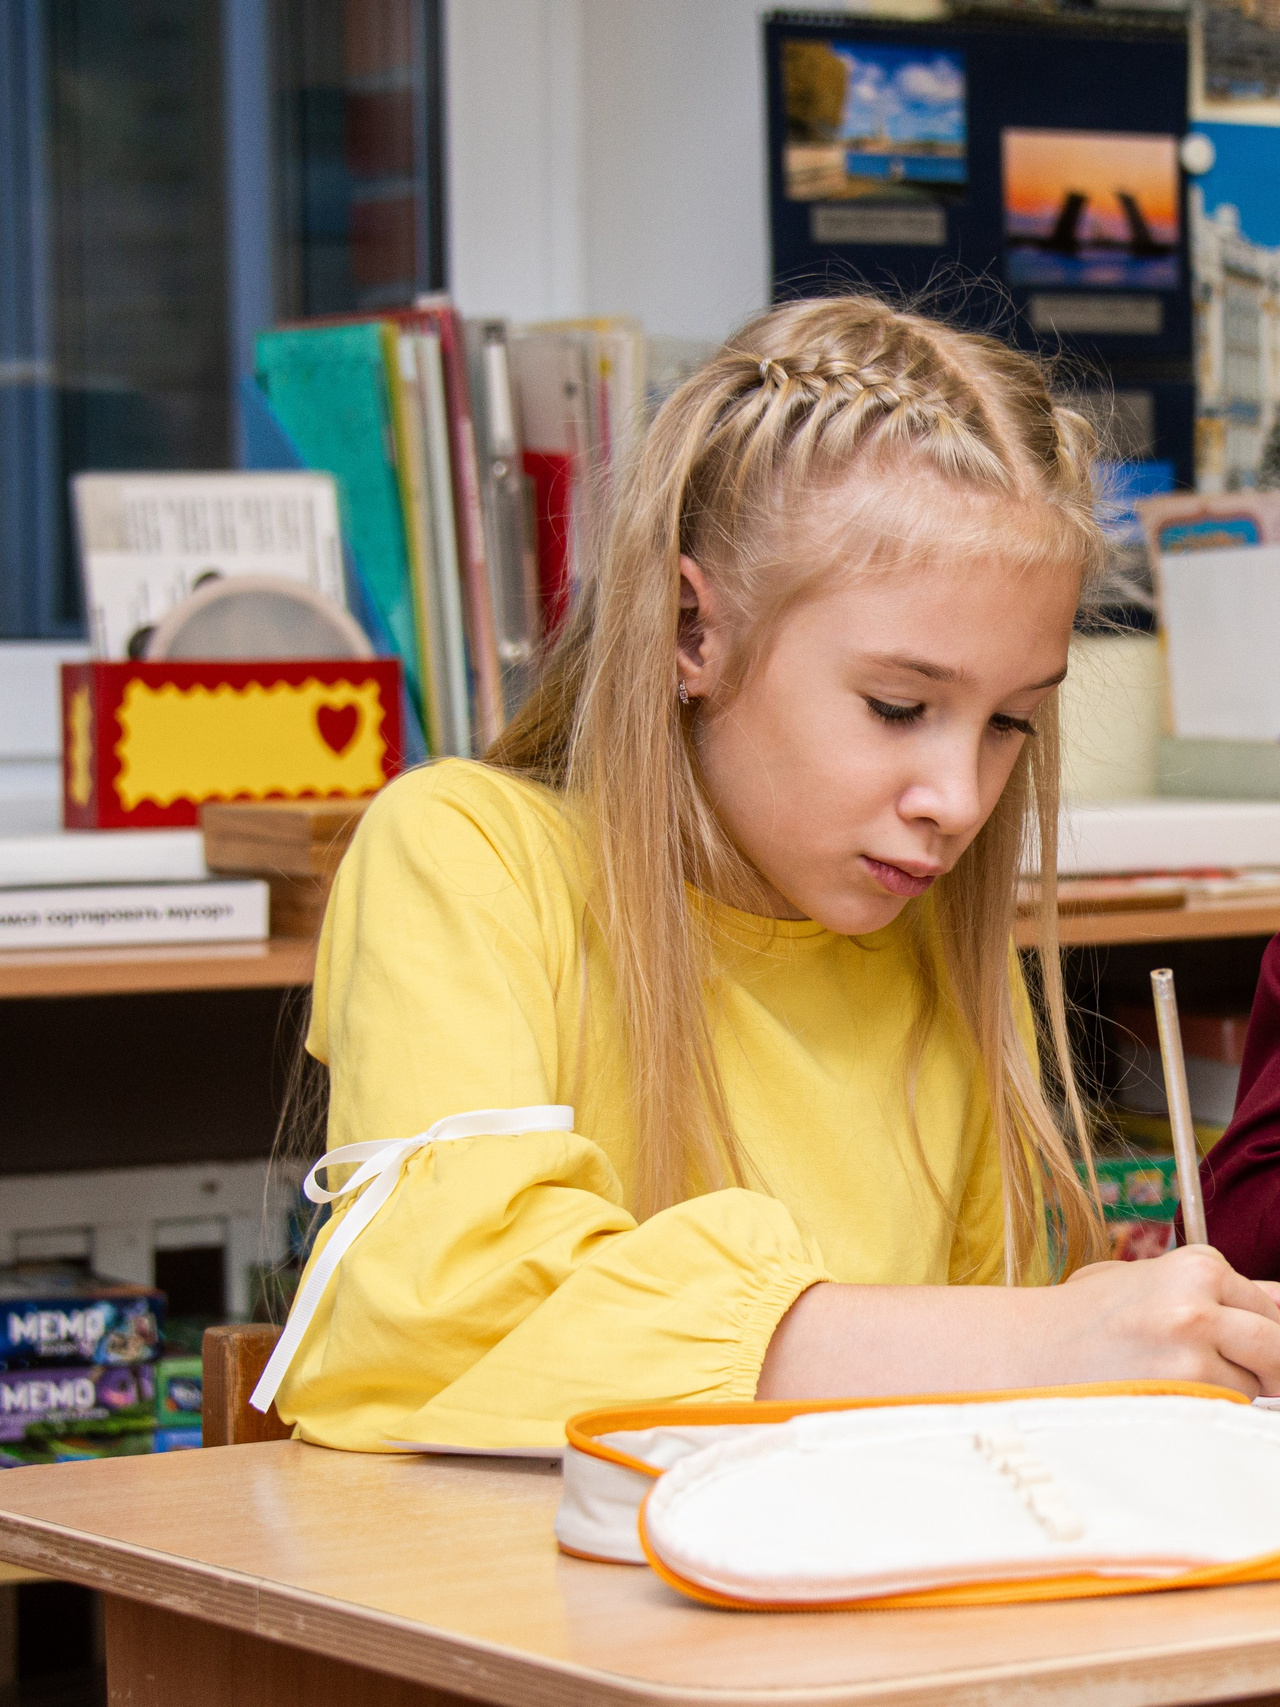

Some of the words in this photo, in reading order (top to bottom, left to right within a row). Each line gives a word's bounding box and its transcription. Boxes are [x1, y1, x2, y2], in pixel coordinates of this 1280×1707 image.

[46, 906, 160, 927] сортировать
[8, 1308, 105, 1345] MEMO
[0, 1378, 95, 1412] MEMO
